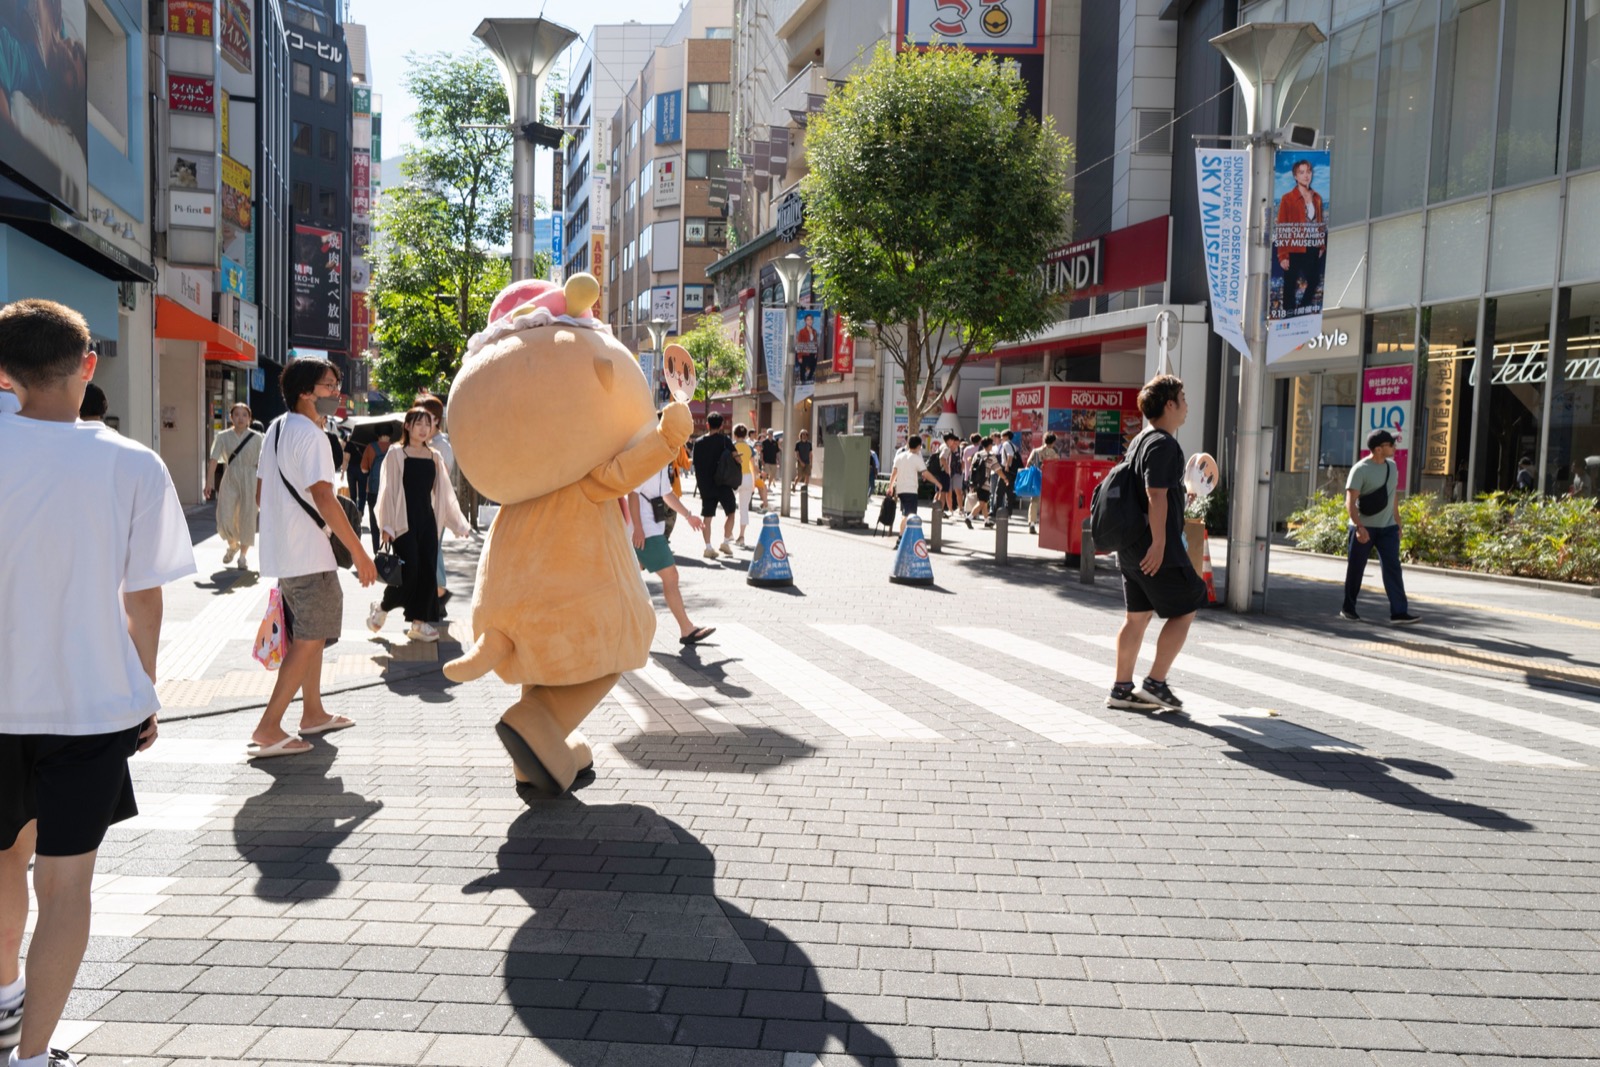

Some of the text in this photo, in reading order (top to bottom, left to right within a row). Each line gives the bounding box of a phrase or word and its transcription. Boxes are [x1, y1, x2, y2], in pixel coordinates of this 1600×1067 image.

[171, 83, 204, 95] タイ古式
[171, 93, 213, 104] マッサージ
[1222, 156, 1232, 220] TENBOU-PARK
[1233, 156, 1243, 207] SUNSHINE
[1232, 210, 1242, 223] 60
[688, 226, 704, 237] (株)
[1201, 155, 1222, 299] SKY MUSEUM
[1221, 228, 1230, 254] EXILE
[1274, 239, 1326, 247] SKY MUSEUM
[1229, 225, 1242, 304] OBSERVATORY
[327, 232, 341, 337] 焼肉食べ放題
[654, 302, 675, 310] タイセイ
[1271, 309, 1287, 318] 9.18
[764, 311, 774, 331] SKY
[1071, 391, 1123, 406] ROUND1
[1375, 387, 1400, 396] おまかせ
[981, 406, 1010, 420] サイゼリヤ
[1370, 405, 1405, 432] UQ
